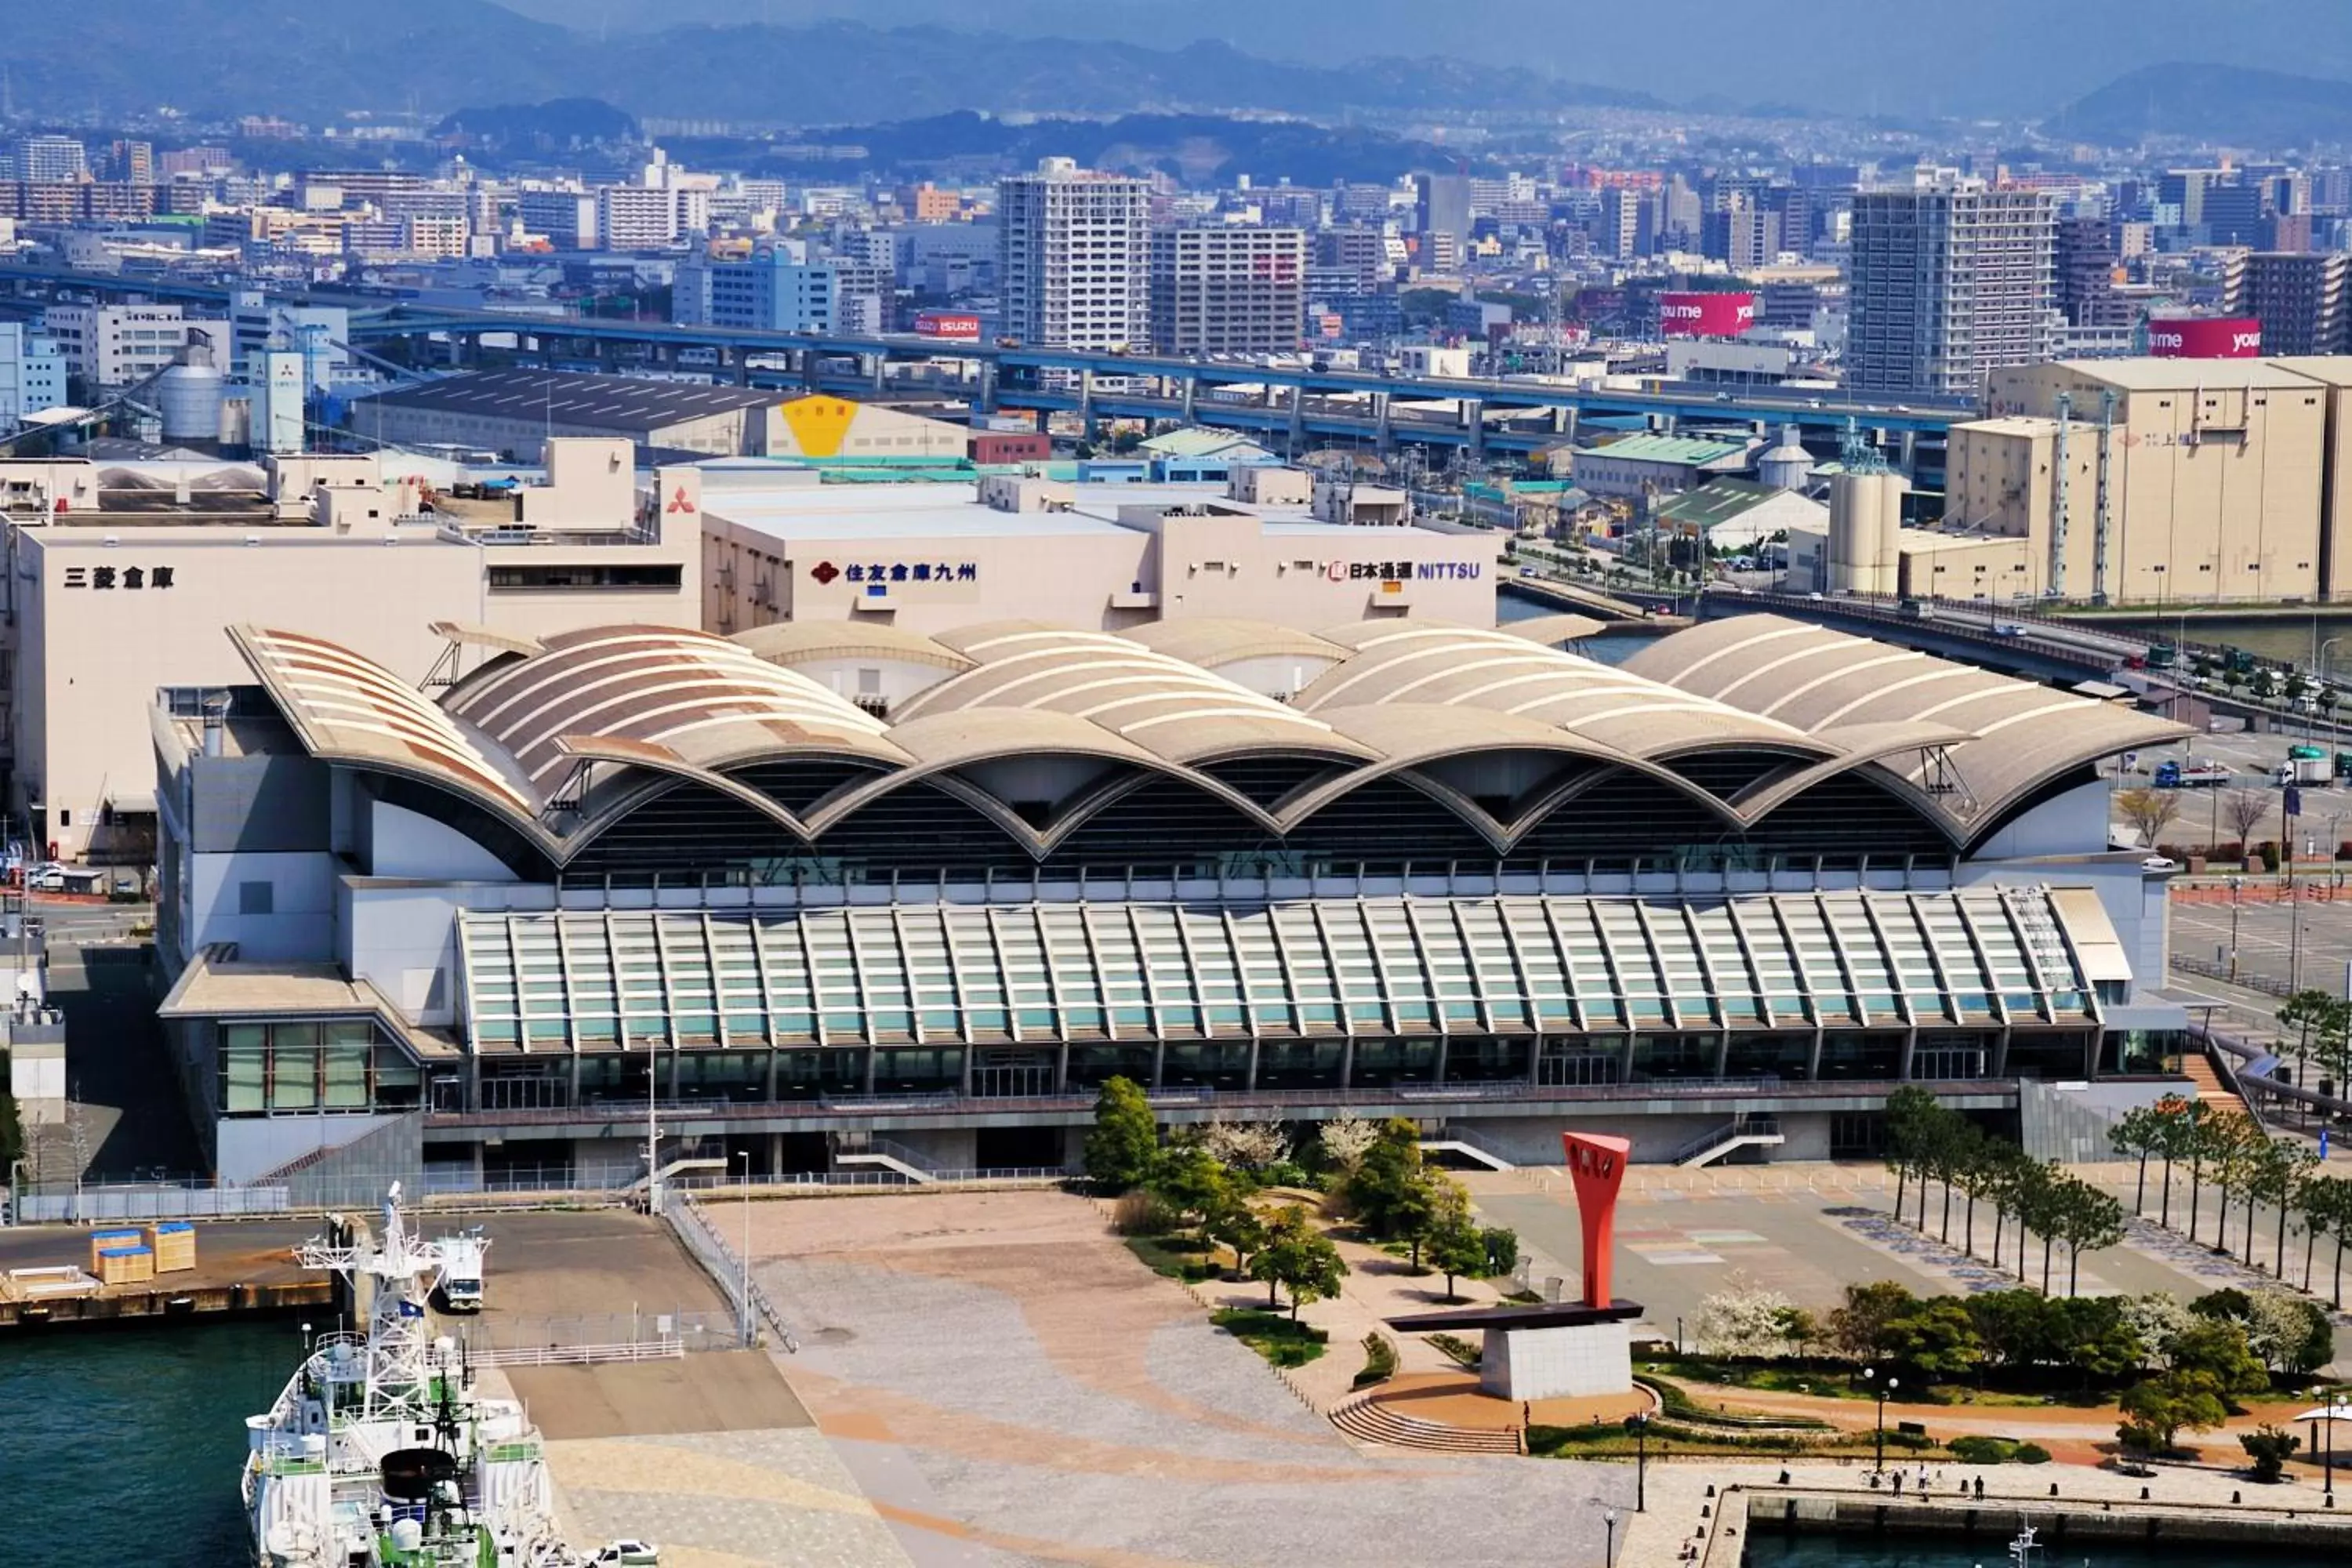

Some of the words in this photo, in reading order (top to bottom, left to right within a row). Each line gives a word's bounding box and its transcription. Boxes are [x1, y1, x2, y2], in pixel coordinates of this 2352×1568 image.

[940, 321, 978, 332] ISUZU
[64, 565, 175, 590] 三菱倉庫
[844, 563, 977, 583] 住友倉庫九州
[1349, 561, 1414, 579] 日本通運
[1417, 561, 1480, 579] NITTSU
